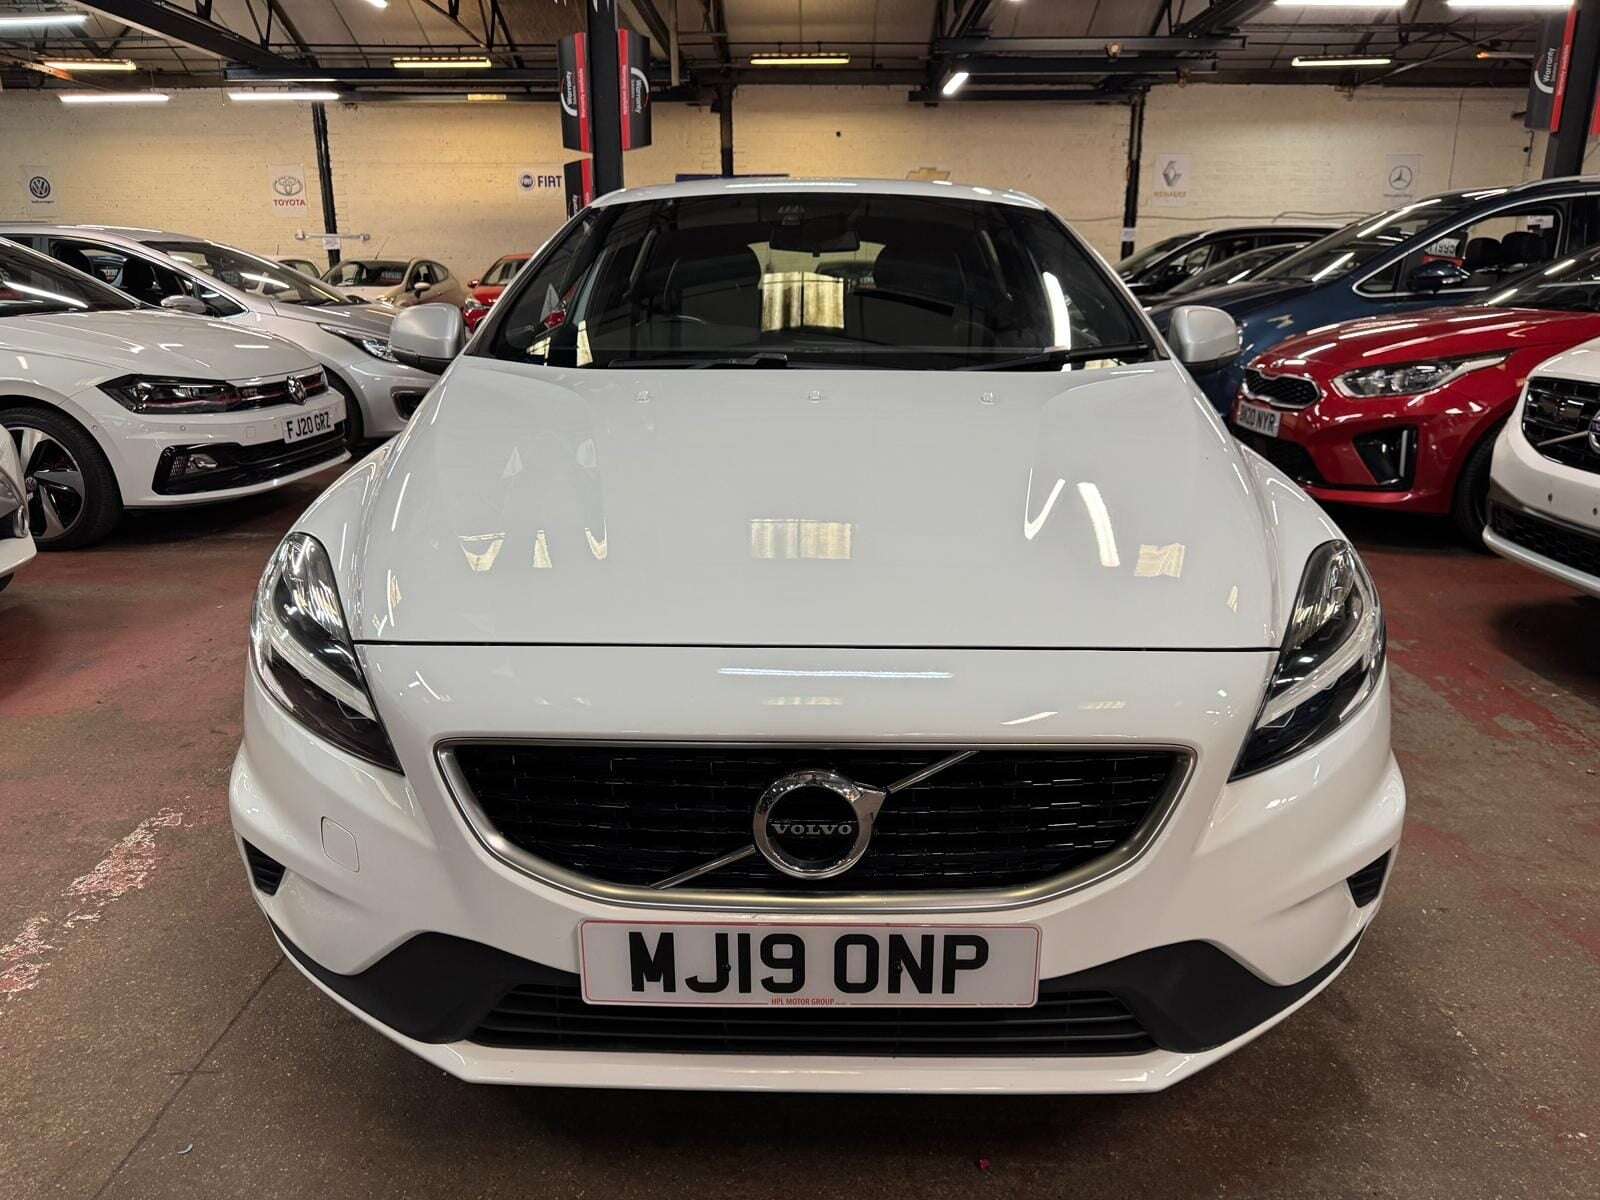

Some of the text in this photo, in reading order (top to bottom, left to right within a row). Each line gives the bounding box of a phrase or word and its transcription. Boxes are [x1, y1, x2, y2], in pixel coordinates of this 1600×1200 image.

[1542, 47, 1557, 82] Warranty
[634, 80, 642, 113] Warranty
[537, 175, 562, 187] FIAT
[273, 199, 306, 207] TOYOTA
[314, 411, 331, 432] GRZ
[1257, 409, 1275, 433] NYR
[771, 824, 852, 835] VOLVO
[629, 931, 989, 994] MJ19 ONP
[771, 997, 834, 1006] HPL MOTOR GROUP
